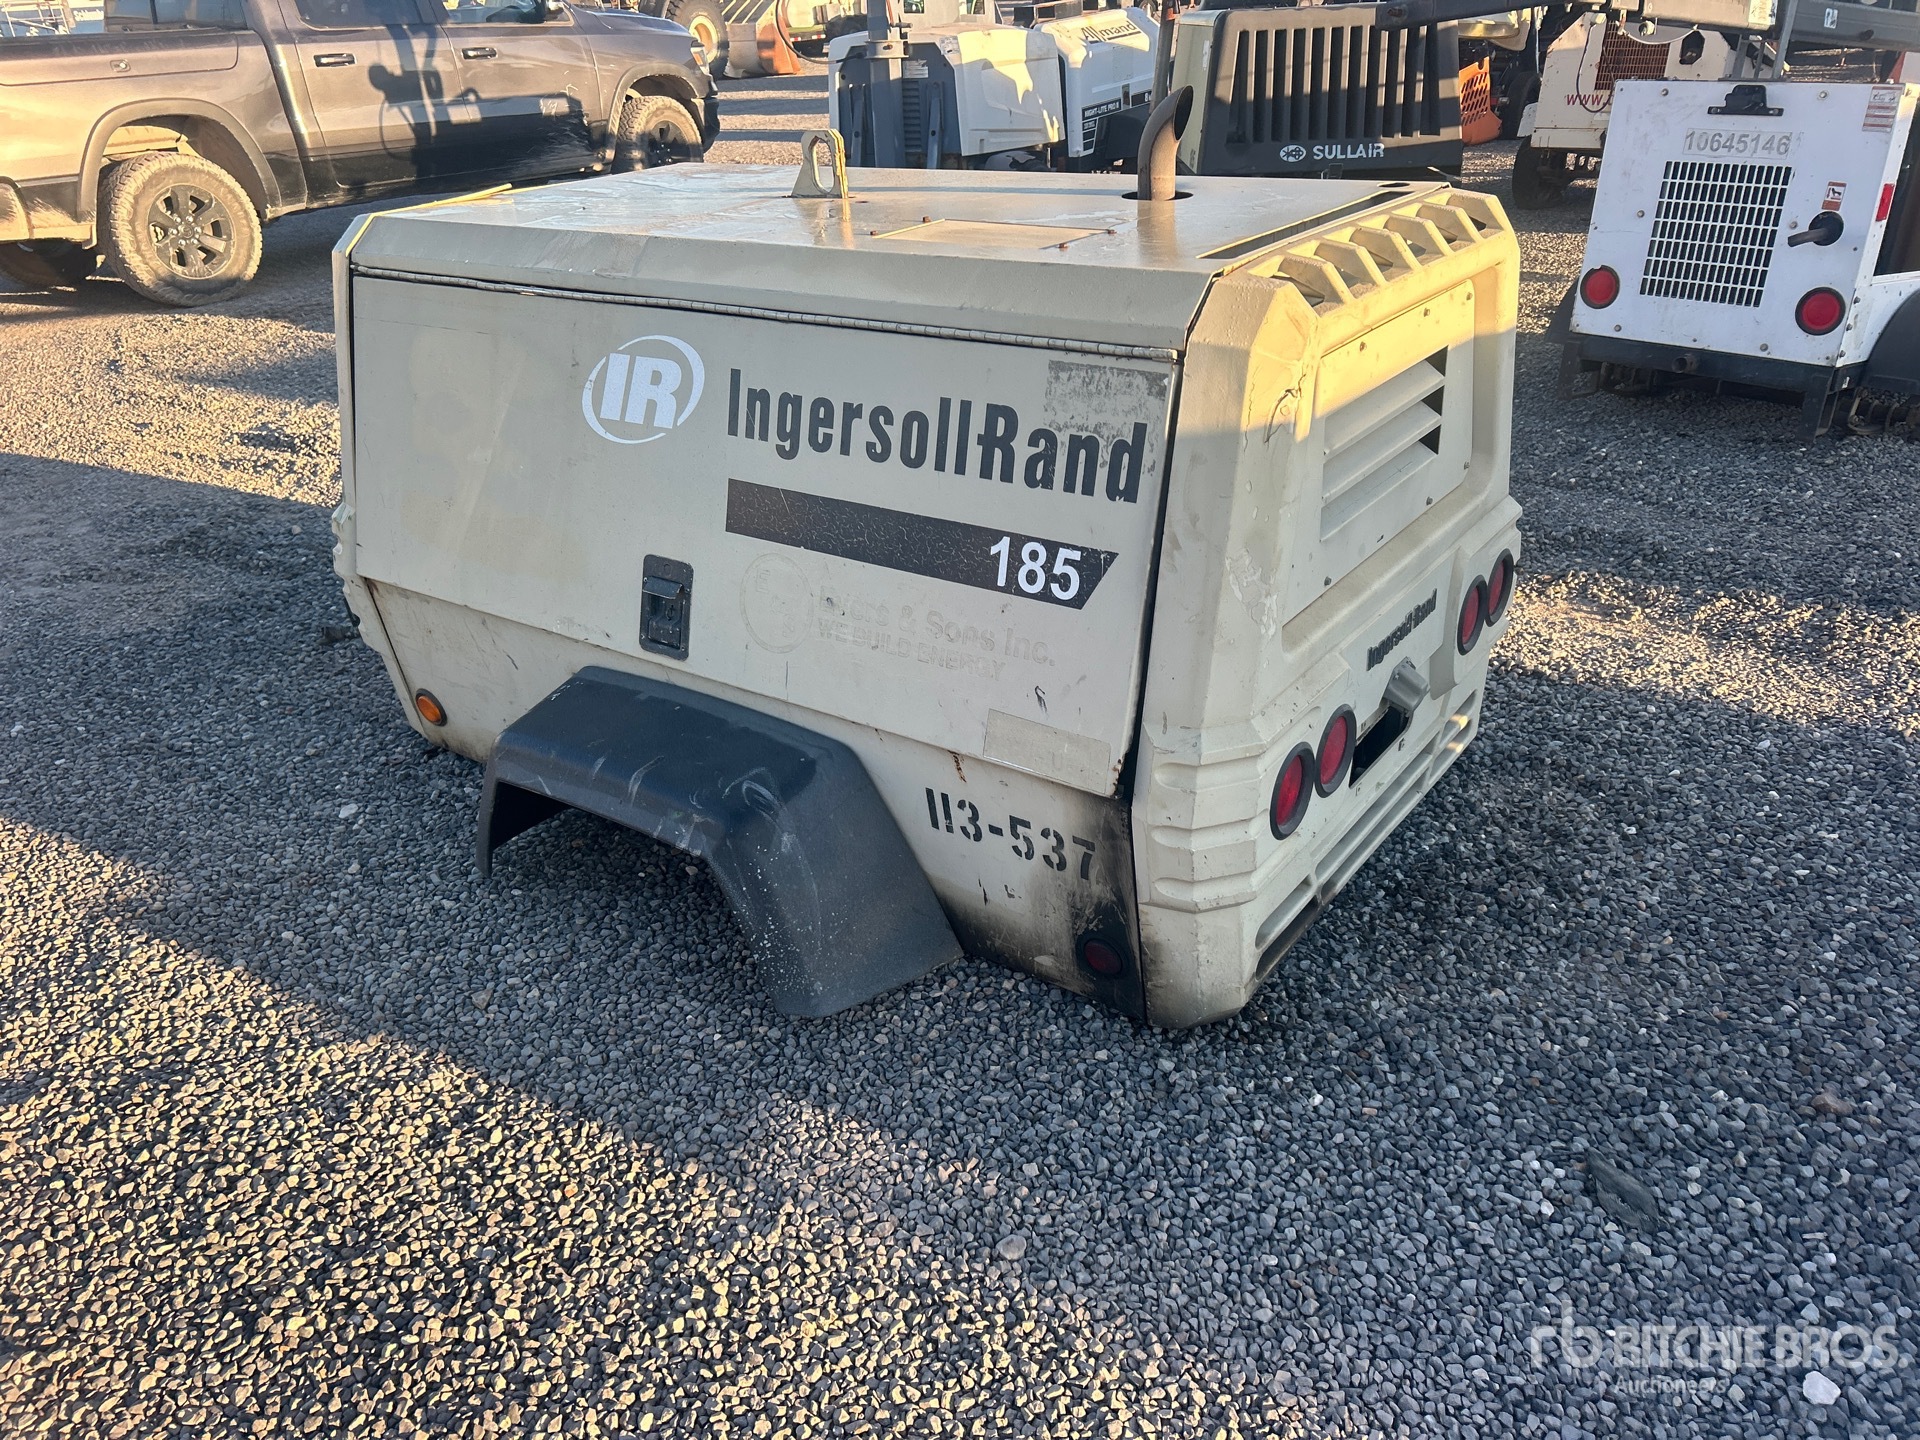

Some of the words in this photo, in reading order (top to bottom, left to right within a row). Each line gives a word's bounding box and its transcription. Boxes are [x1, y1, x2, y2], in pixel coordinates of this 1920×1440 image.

[1081, 20, 1137, 42] Allmand
[1312, 143, 1385, 160] SULLAIR
[1684, 129, 1792, 156] 10645146
[600, 352, 682, 429] IR
[990, 535, 1082, 601] 185
[916, 641, 1007, 682] ENERGY
[1004, 627, 1056, 667] Inc.
[925, 787, 1096, 880] 113-537
